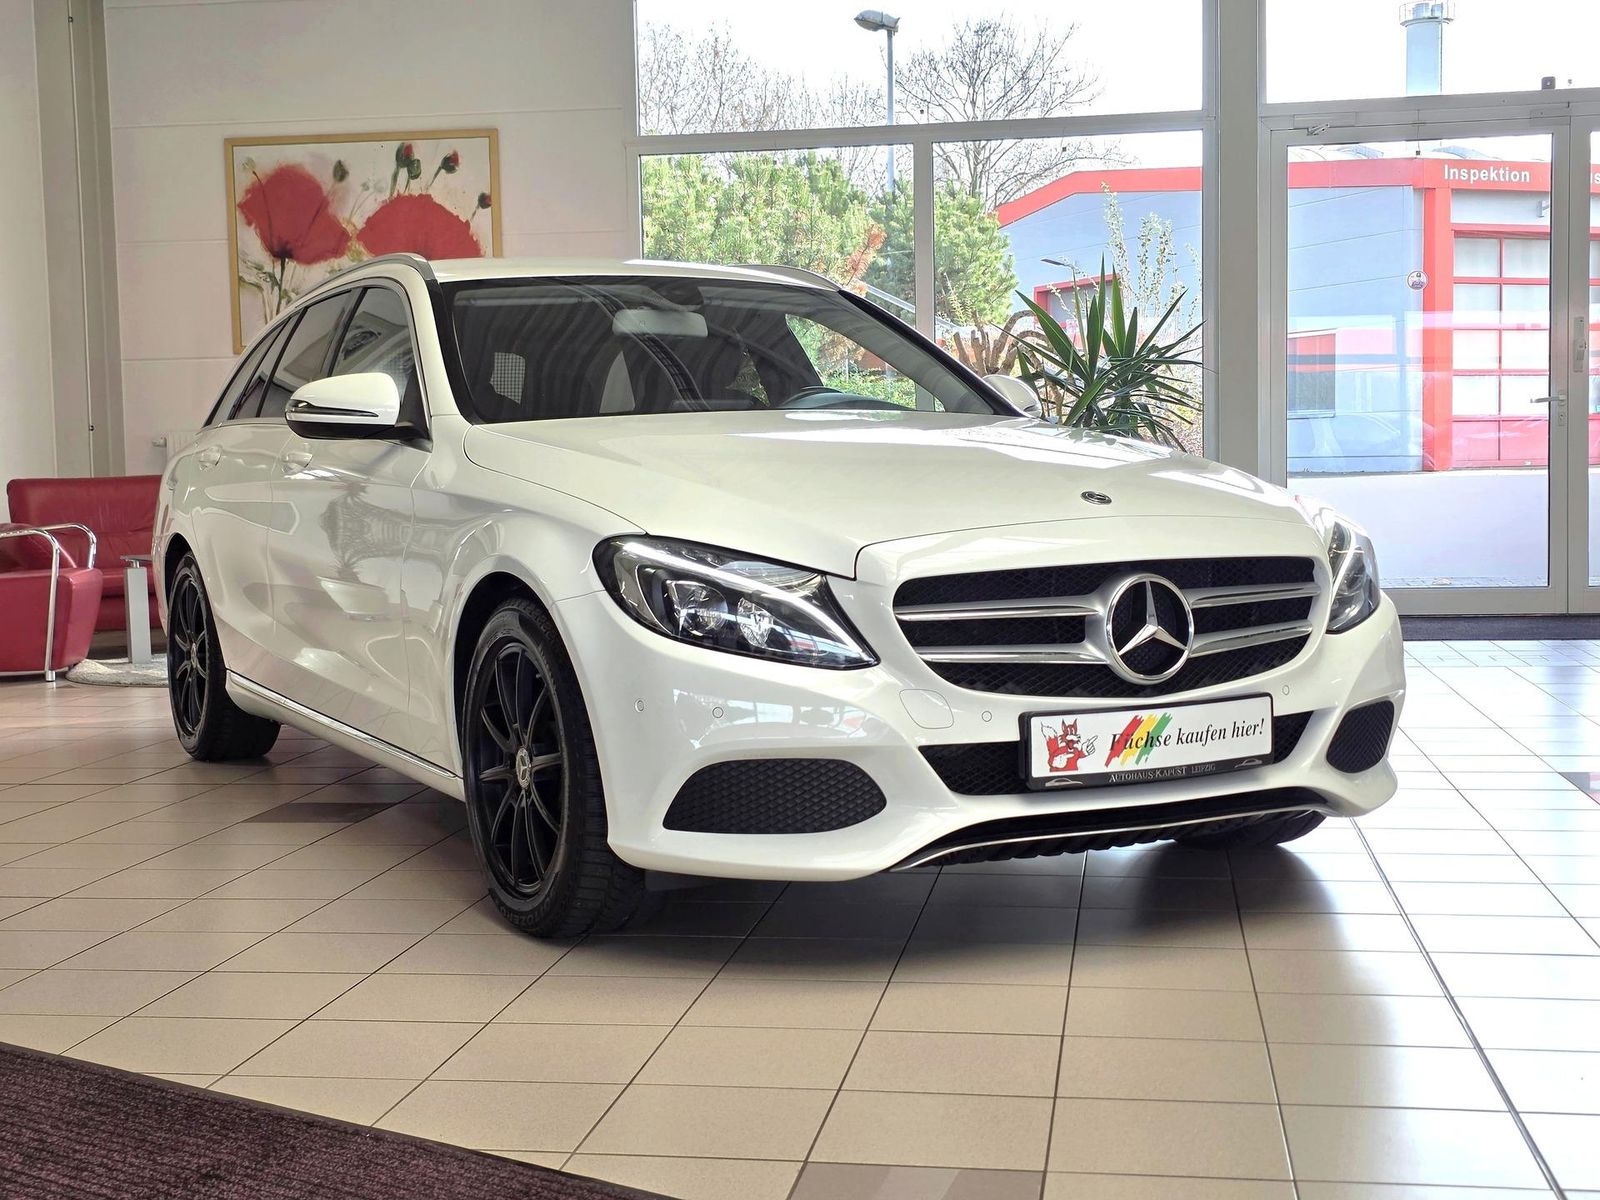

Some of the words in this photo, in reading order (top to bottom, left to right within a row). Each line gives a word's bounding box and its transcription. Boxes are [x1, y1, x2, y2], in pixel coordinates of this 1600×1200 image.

[1444, 164, 1530, 184] Inspektion
[1176, 724, 1226, 747] kaufen
[1231, 718, 1264, 739] hier!
